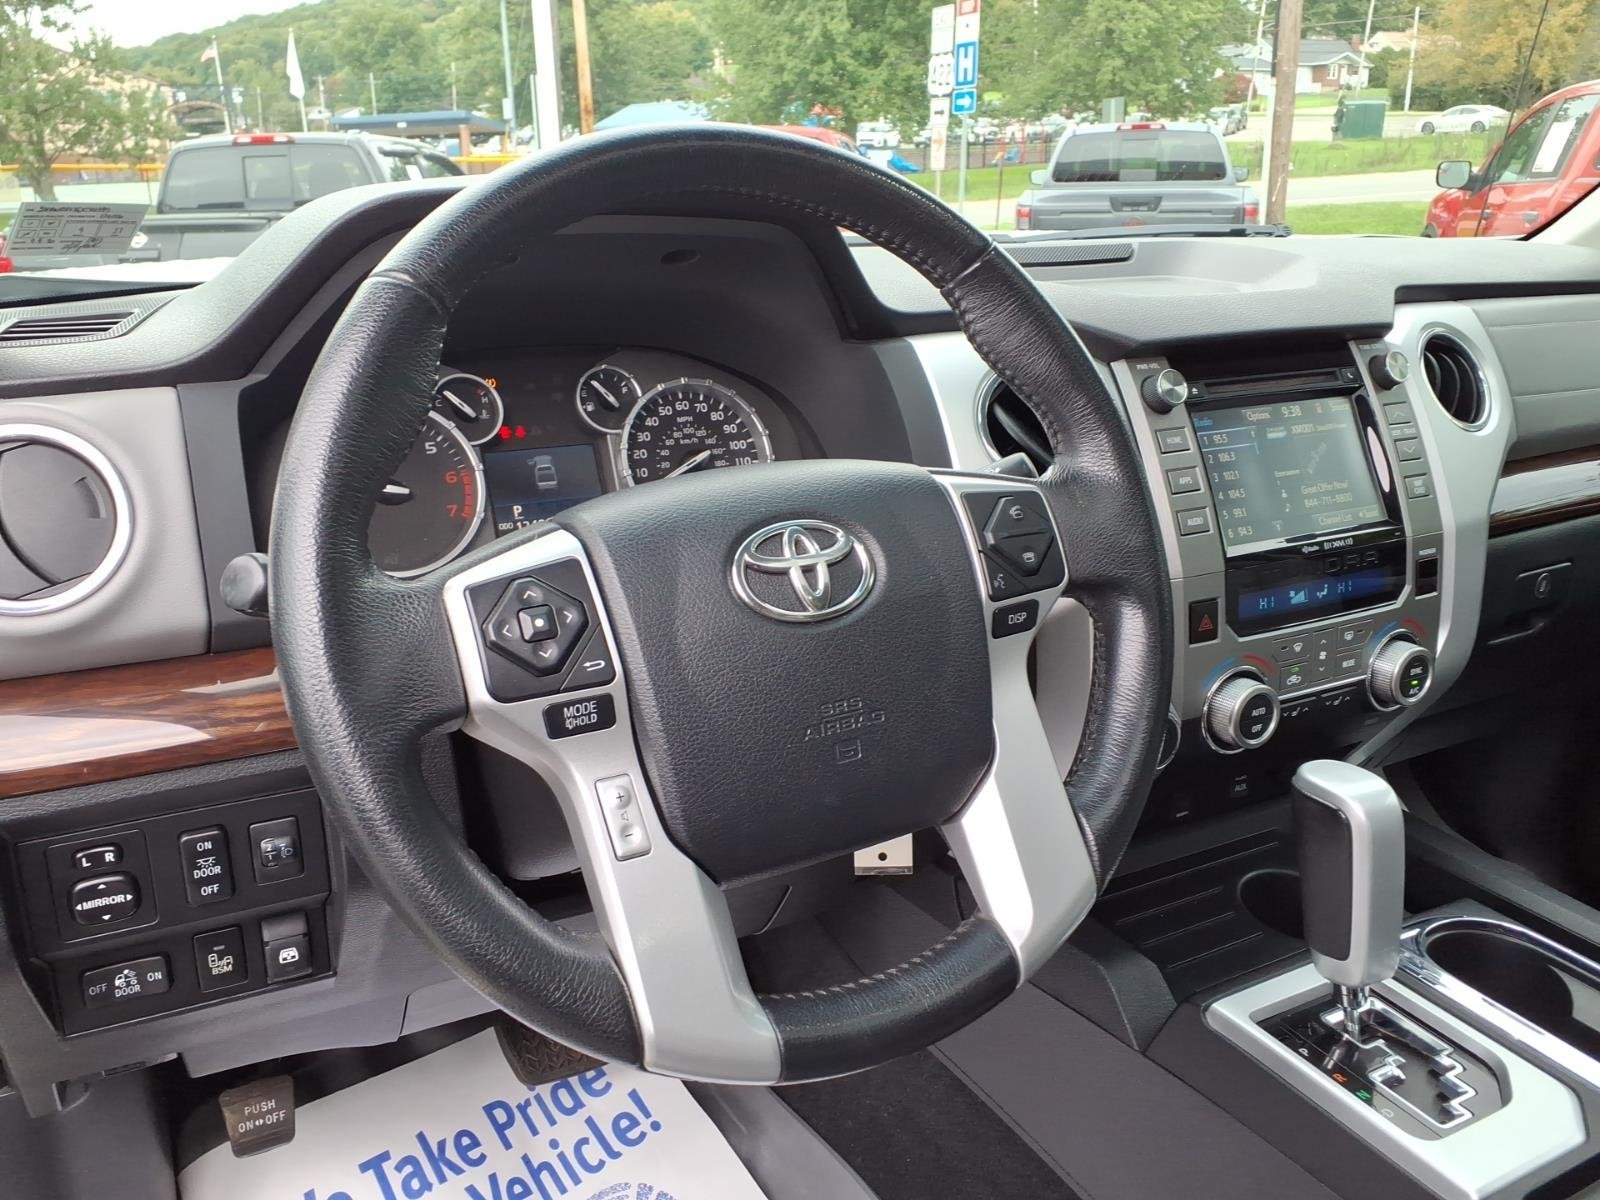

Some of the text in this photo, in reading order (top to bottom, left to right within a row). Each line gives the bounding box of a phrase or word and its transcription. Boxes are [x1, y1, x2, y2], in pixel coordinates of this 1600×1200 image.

[958, 47, 974, 82] H
[481, 396, 489, 404] H
[675, 400, 689, 410] 60
[658, 405, 673, 416] 50
[694, 402, 708, 413] 70
[1281, 405, 1302, 417] 9:38
[645, 416, 659, 426] 40
[710, 411, 724, 421] 80
[723, 423, 737, 434] 90
[636, 432, 651, 442] 30
[680, 436, 699, 445] km/h
[424, 441, 437, 454] 5
[729, 440, 747, 450] 100
[633, 449, 648, 459] 20
[1208, 454, 1214, 464] 2
[735, 456, 751, 465] 110
[445, 472, 457, 484] 6
[636, 468, 648, 478] 10
[1213, 472, 1219, 482] 3
[1218, 491, 1224, 500] 4
[446, 504, 458, 517] 7
[512, 505, 523, 517] P
[1223, 510, 1229, 519] 5
[498, 522, 514, 530] ODO
[1228, 528, 1234, 538] 6
[1008, 611, 1027, 625] DISP
[563, 700, 598, 719] MODE
[1251, 706, 1266, 717] AUTO
[573, 713, 598, 727] HOLD
[1251, 723, 1263, 733] OFF
[197, 841, 212, 852] ON
[82, 851, 115, 868] L R
[193, 864, 221, 879] DOOR
[201, 883, 220, 897] OFF
[82, 893, 126, 910] MIRROR
[211, 964, 233, 976] BSM
[147, 971, 162, 983] ON
[89, 982, 108, 996] OFF
[114, 984, 141, 998] DOOR
[244, 1098, 276, 1117] PUSH
[238, 1109, 287, 1133] ON OFF
[358, 1066, 613, 1200] Take Pride
